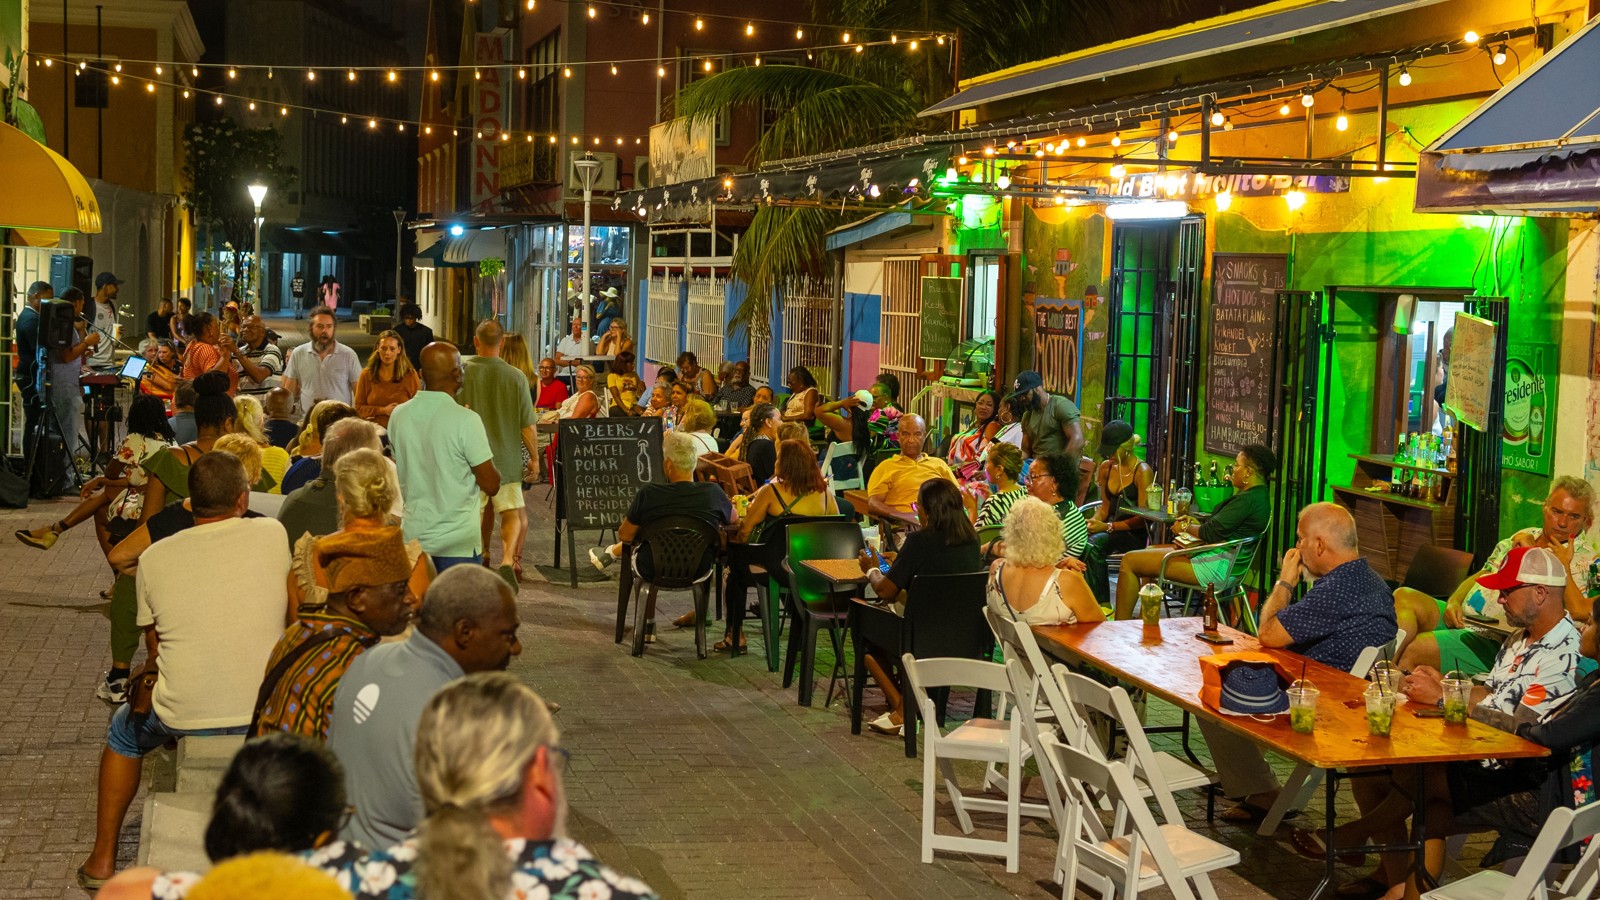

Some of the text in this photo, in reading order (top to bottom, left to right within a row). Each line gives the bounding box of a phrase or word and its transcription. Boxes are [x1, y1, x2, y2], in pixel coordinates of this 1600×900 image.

[1139, 174, 1187, 197] Bt
[1226, 261, 1258, 280] SNACKS
[1225, 289, 1240, 306] HOT
[1241, 290, 1257, 306] DOG
[1037, 312, 1046, 328] THE
[1065, 314, 1077, 330] BEST
[1035, 332, 1076, 395] MOJITO
[1504, 373, 1545, 403] esidente
[1211, 397, 1240, 413] CHICKEN
[1215, 412, 1232, 424] WINGS
[585, 423, 635, 438] BEERS
[573, 444, 625, 457] AMSTEL
[575, 457, 618, 472] POLAR
